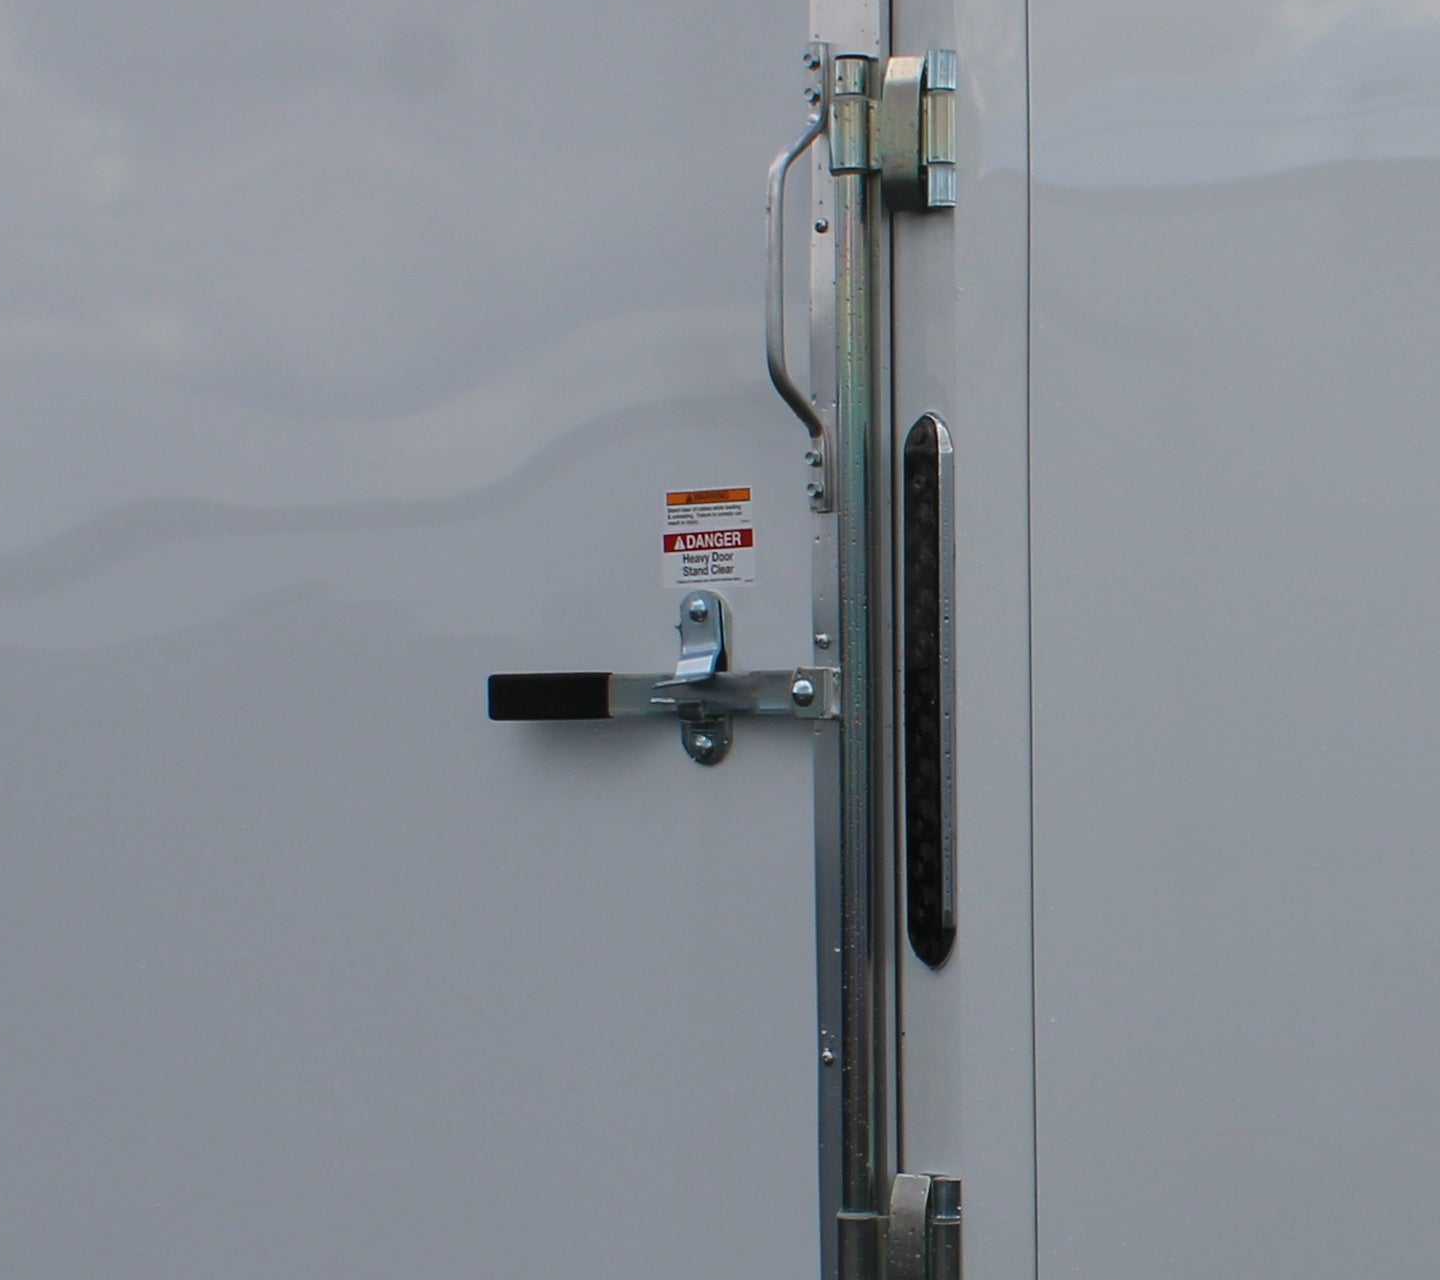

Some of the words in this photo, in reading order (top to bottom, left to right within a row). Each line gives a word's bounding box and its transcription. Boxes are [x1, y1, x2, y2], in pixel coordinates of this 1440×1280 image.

[686, 531, 742, 550] DANGER
[683, 553, 710, 565] Heavy
[712, 551, 734, 562] Door
[683, 565, 709, 577] Stand
[711, 564, 734, 575] Clear
